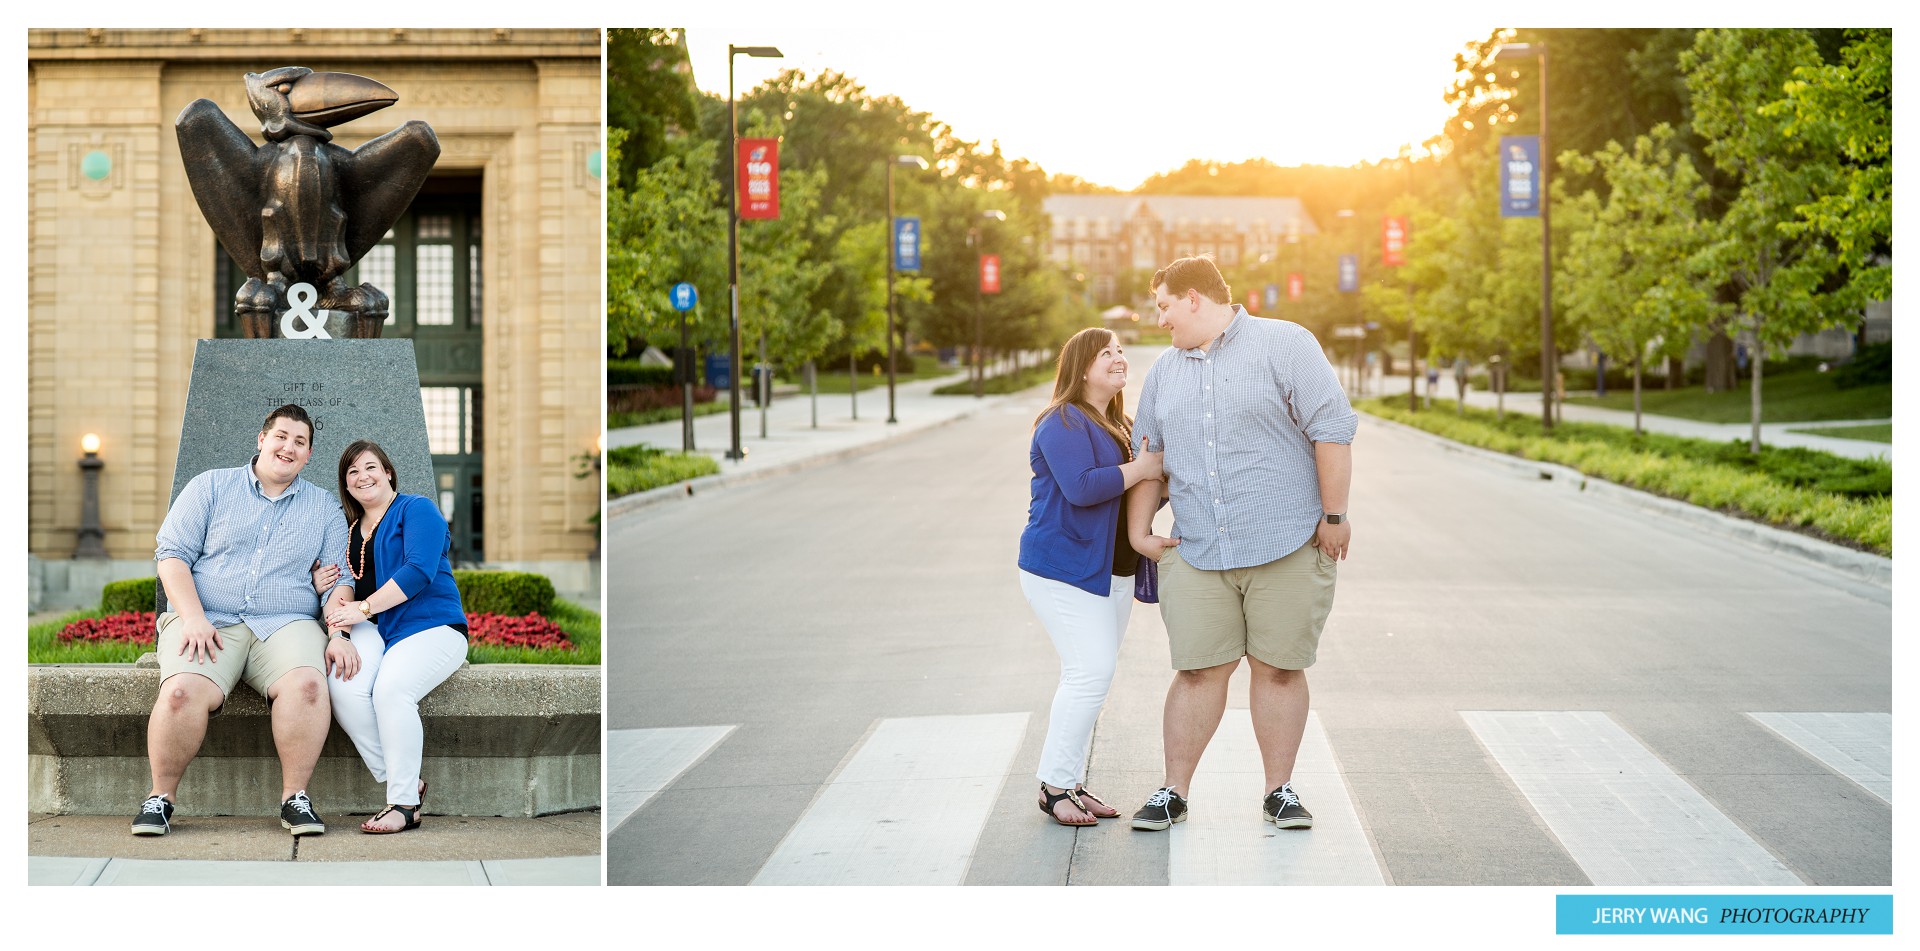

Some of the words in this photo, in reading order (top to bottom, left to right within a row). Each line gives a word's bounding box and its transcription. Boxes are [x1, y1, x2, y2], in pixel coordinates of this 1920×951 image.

[408, 86, 505, 105] KANSAS
[280, 282, 333, 340] &
[283, 382, 306, 392] GIFT
[312, 382, 325, 392] OF
[267, 397, 286, 407] THE
[292, 397, 323, 407] CLASS
[329, 397, 343, 407] OF
